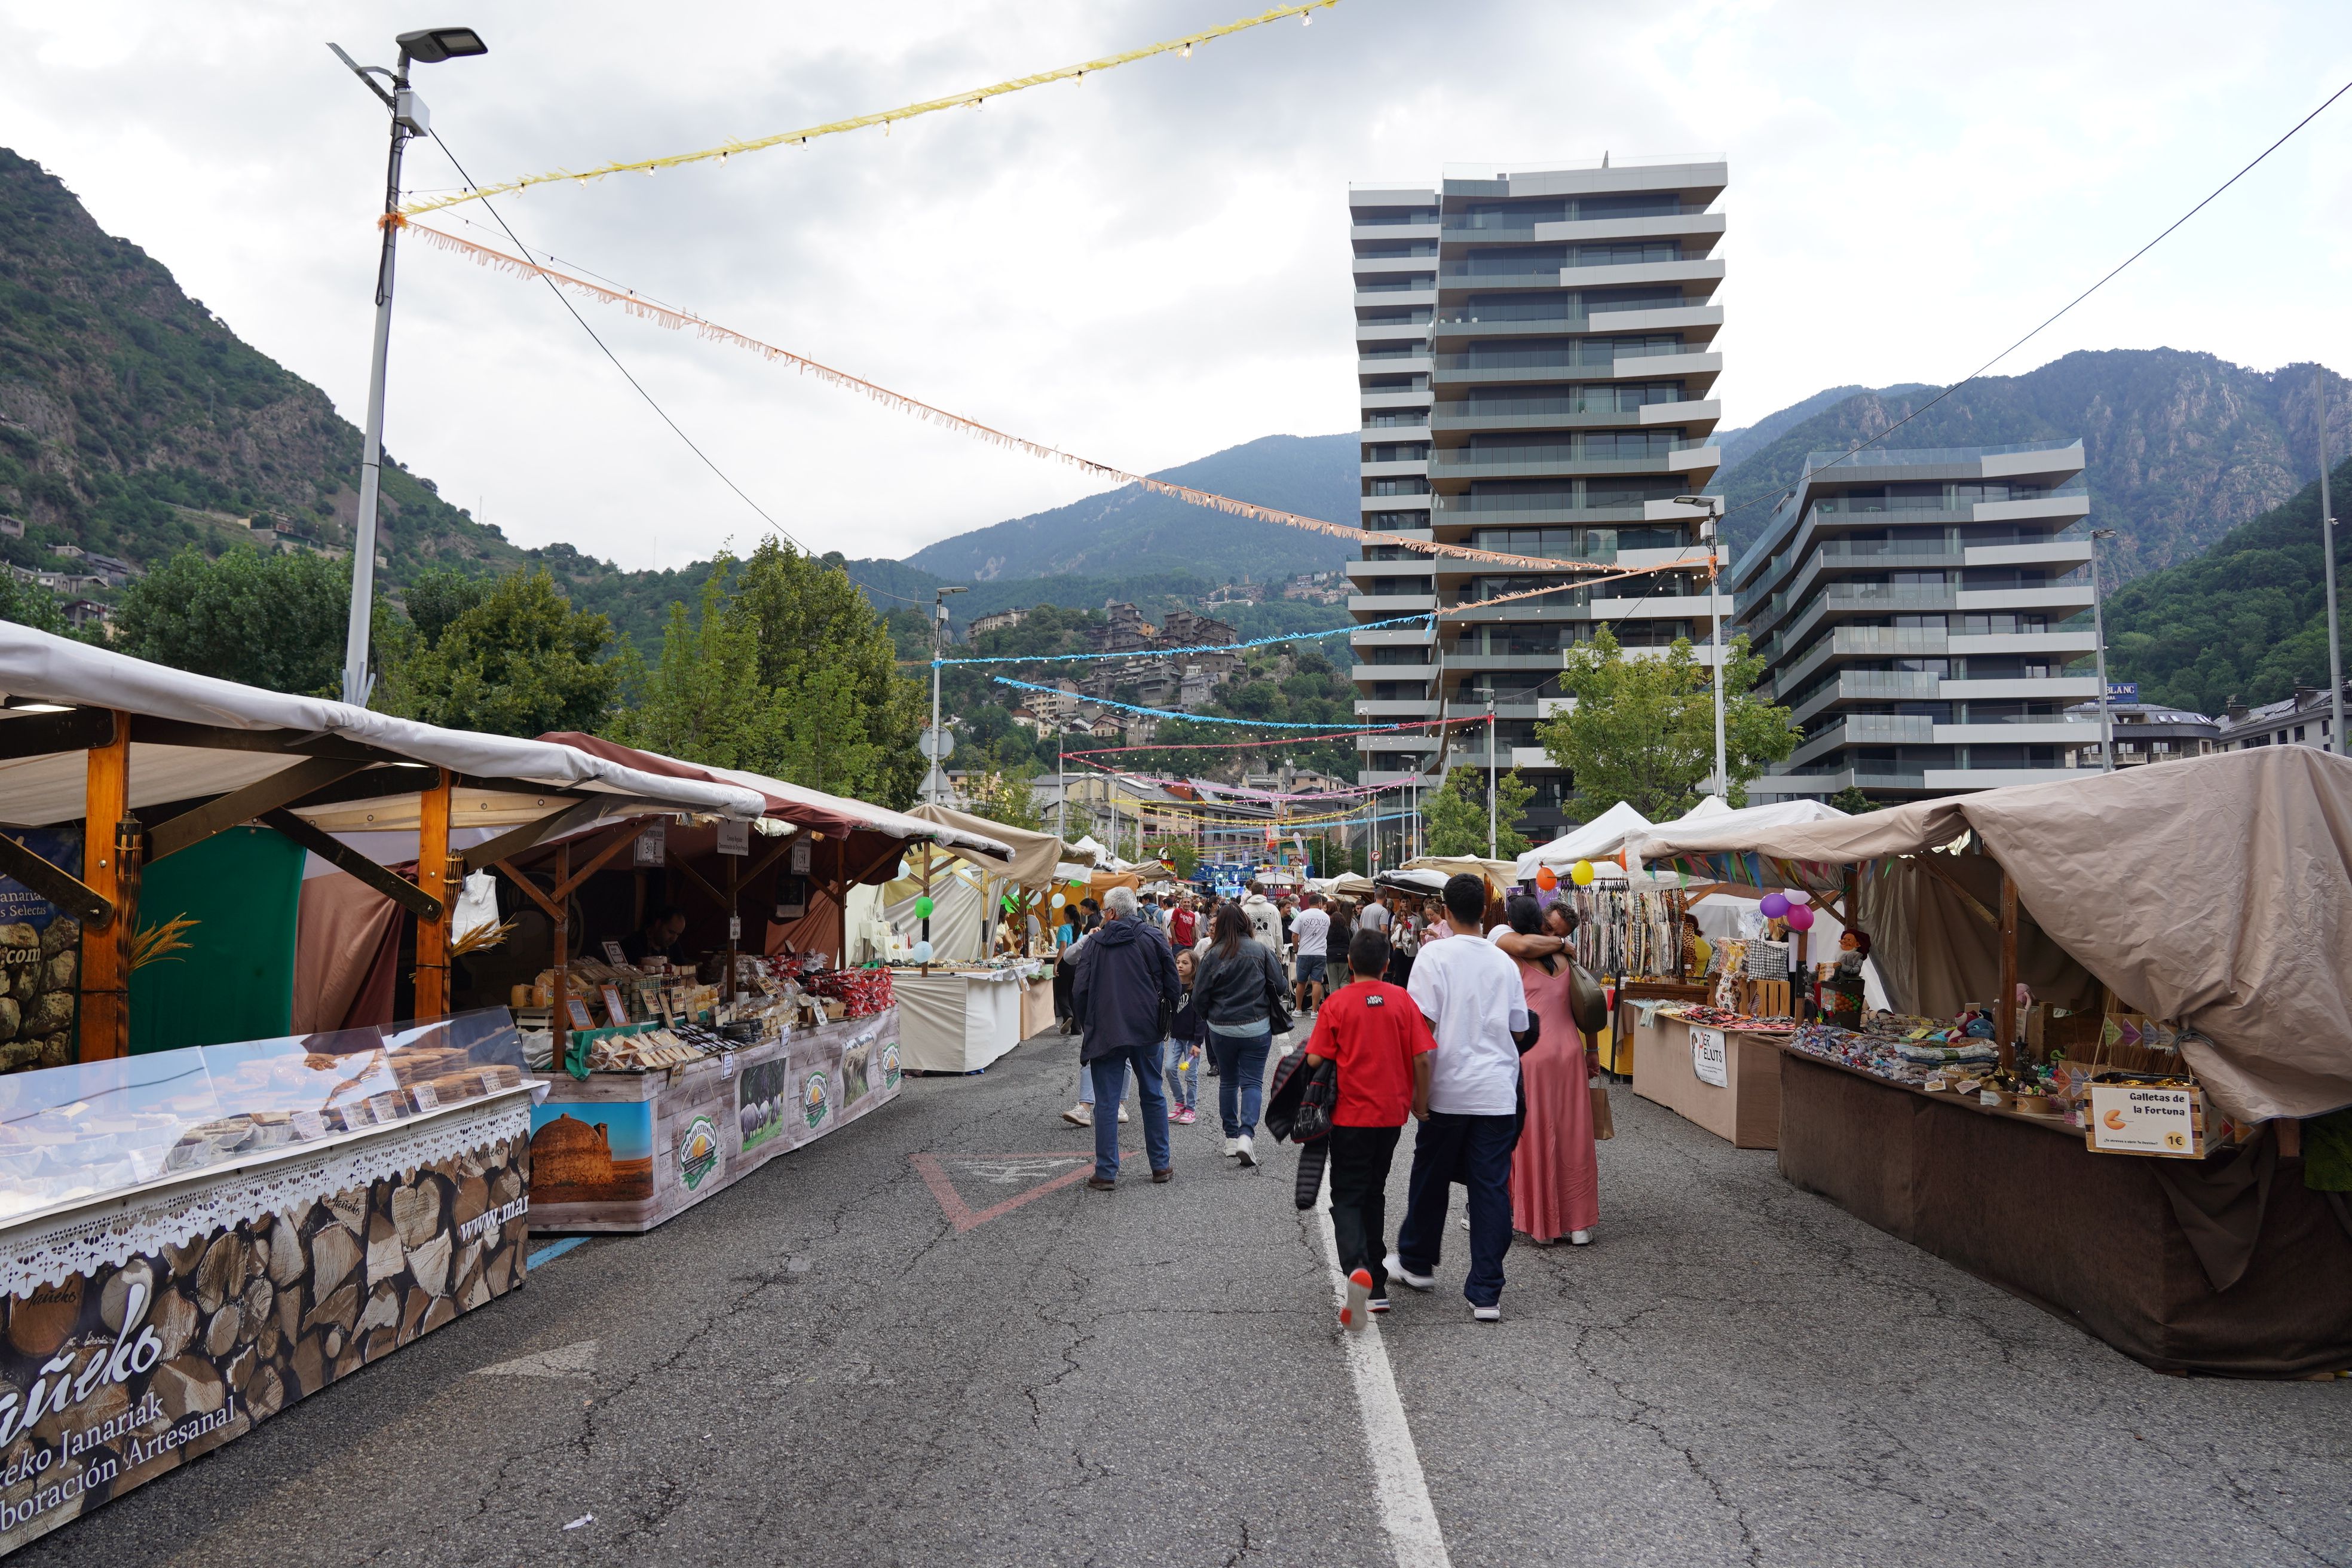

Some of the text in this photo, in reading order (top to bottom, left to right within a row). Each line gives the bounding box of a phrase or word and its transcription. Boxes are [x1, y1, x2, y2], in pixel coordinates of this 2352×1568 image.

[10, 904, 47, 917] Selectas
[2130, 1092, 2170, 1102] Galletas
[2133, 1105, 2185, 1116] la Fortuna
[682, 1129, 697, 1157] BOCAITO
[2168, 1136, 2182, 1146] 1€
[60, 1391, 164, 1469] Janariak
[126, 1395, 236, 1471] Artesanal
